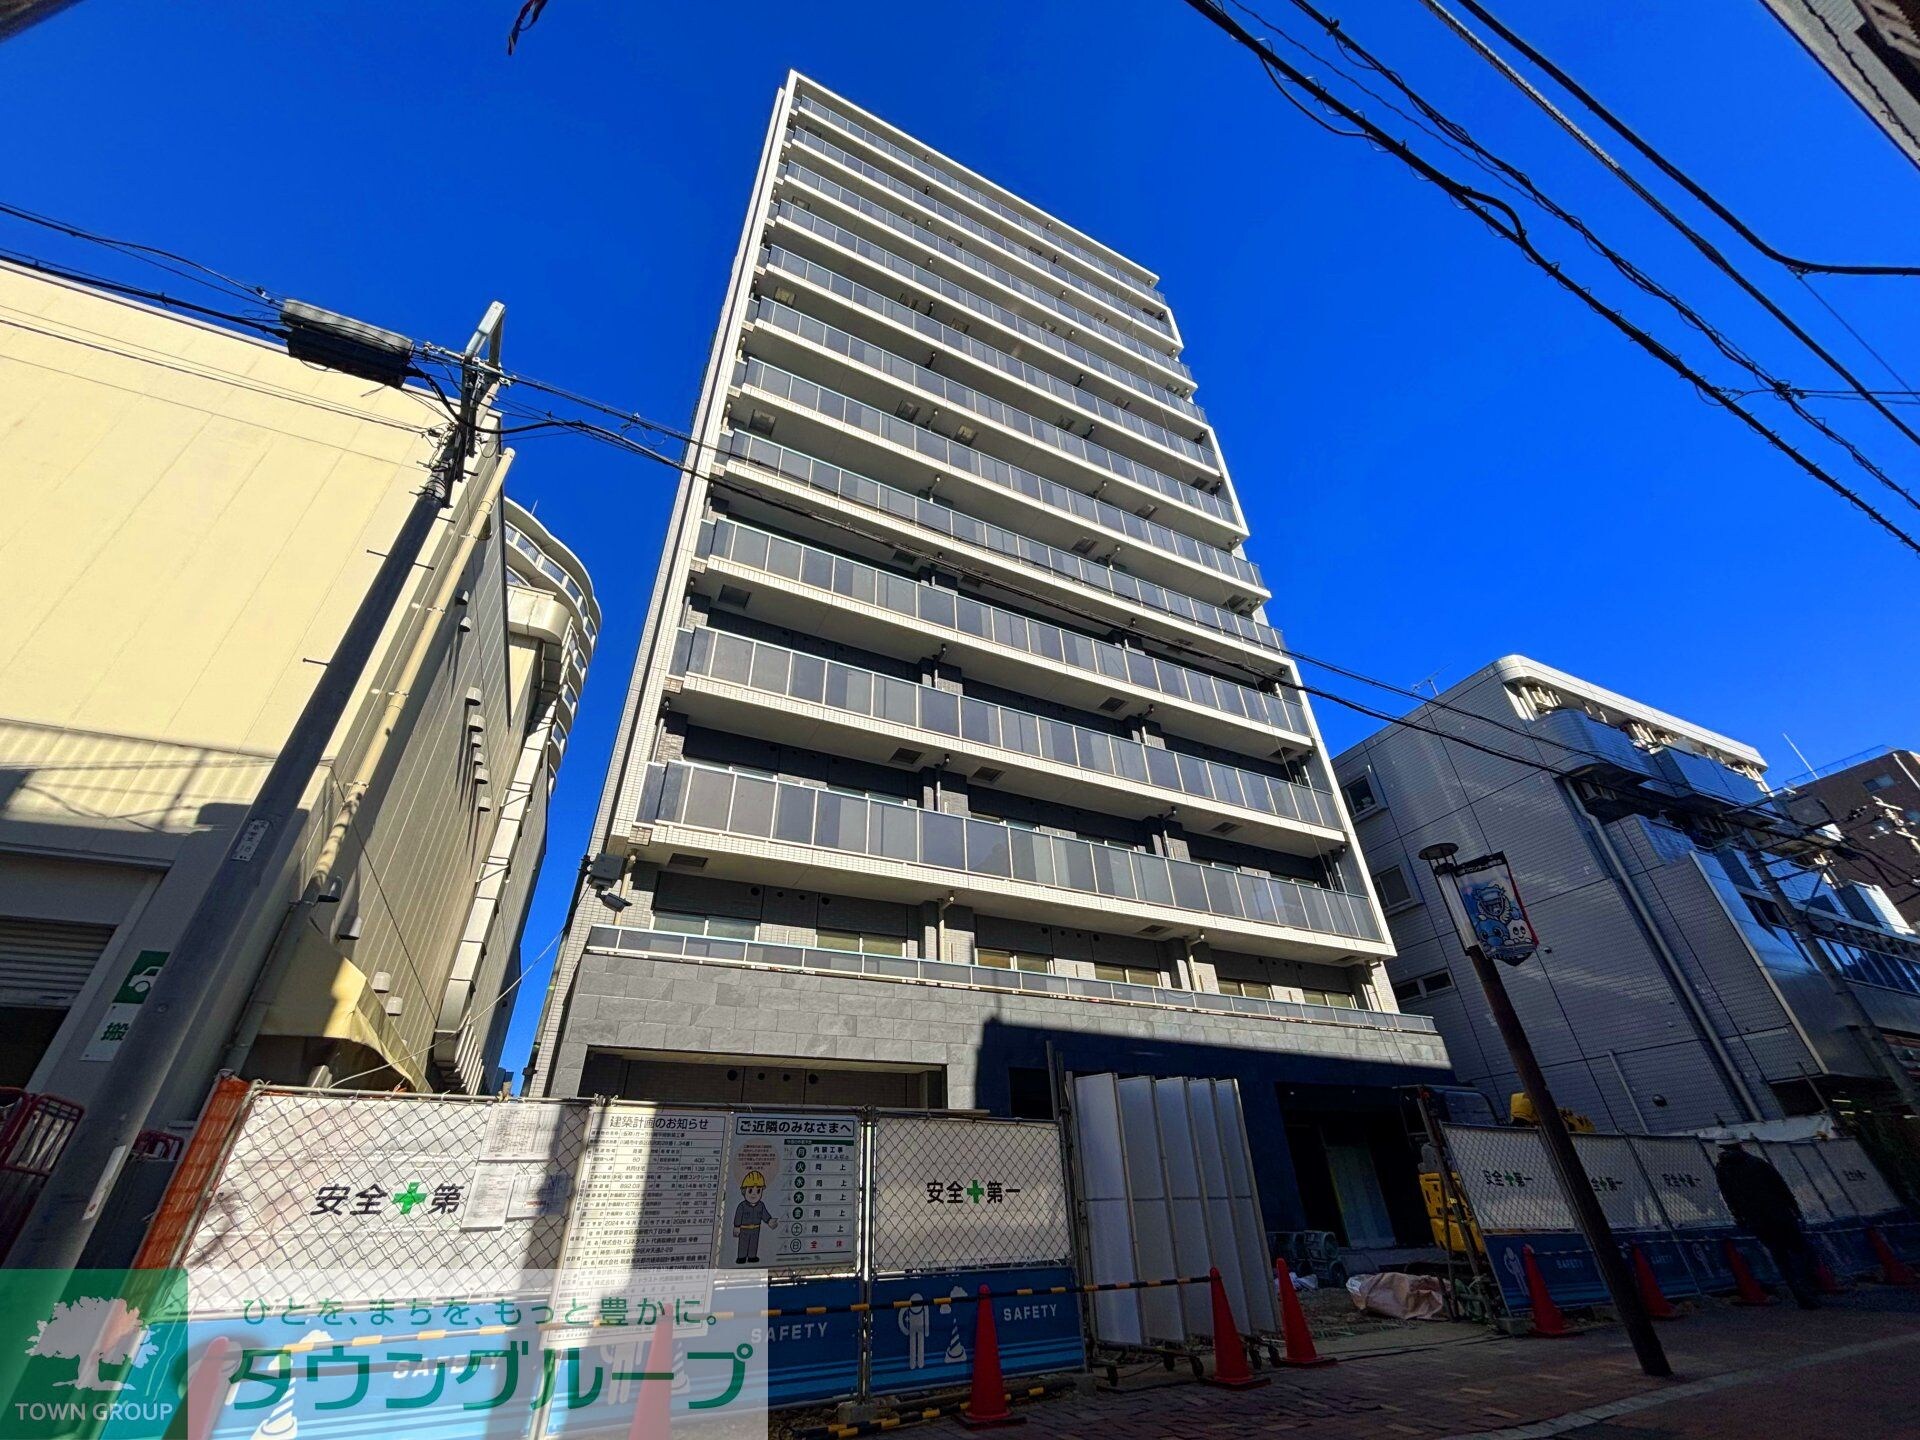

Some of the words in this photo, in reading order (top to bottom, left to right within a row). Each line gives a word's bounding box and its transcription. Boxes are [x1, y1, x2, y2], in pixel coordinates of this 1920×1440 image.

[610, 1116, 708, 1130] 建築計画のお知らせ
[740, 1120, 851, 1133] ご近隣のみなさまへ
[310, 1183, 388, 1216] 安全
[428, 1183, 465, 1214] 第
[927, 1180, 964, 1204] 安全
[987, 1180, 1020, 1204] 第一
[1003, 1304, 1057, 1321] SAFETY
[751, 1322, 828, 1344] SAFETY
